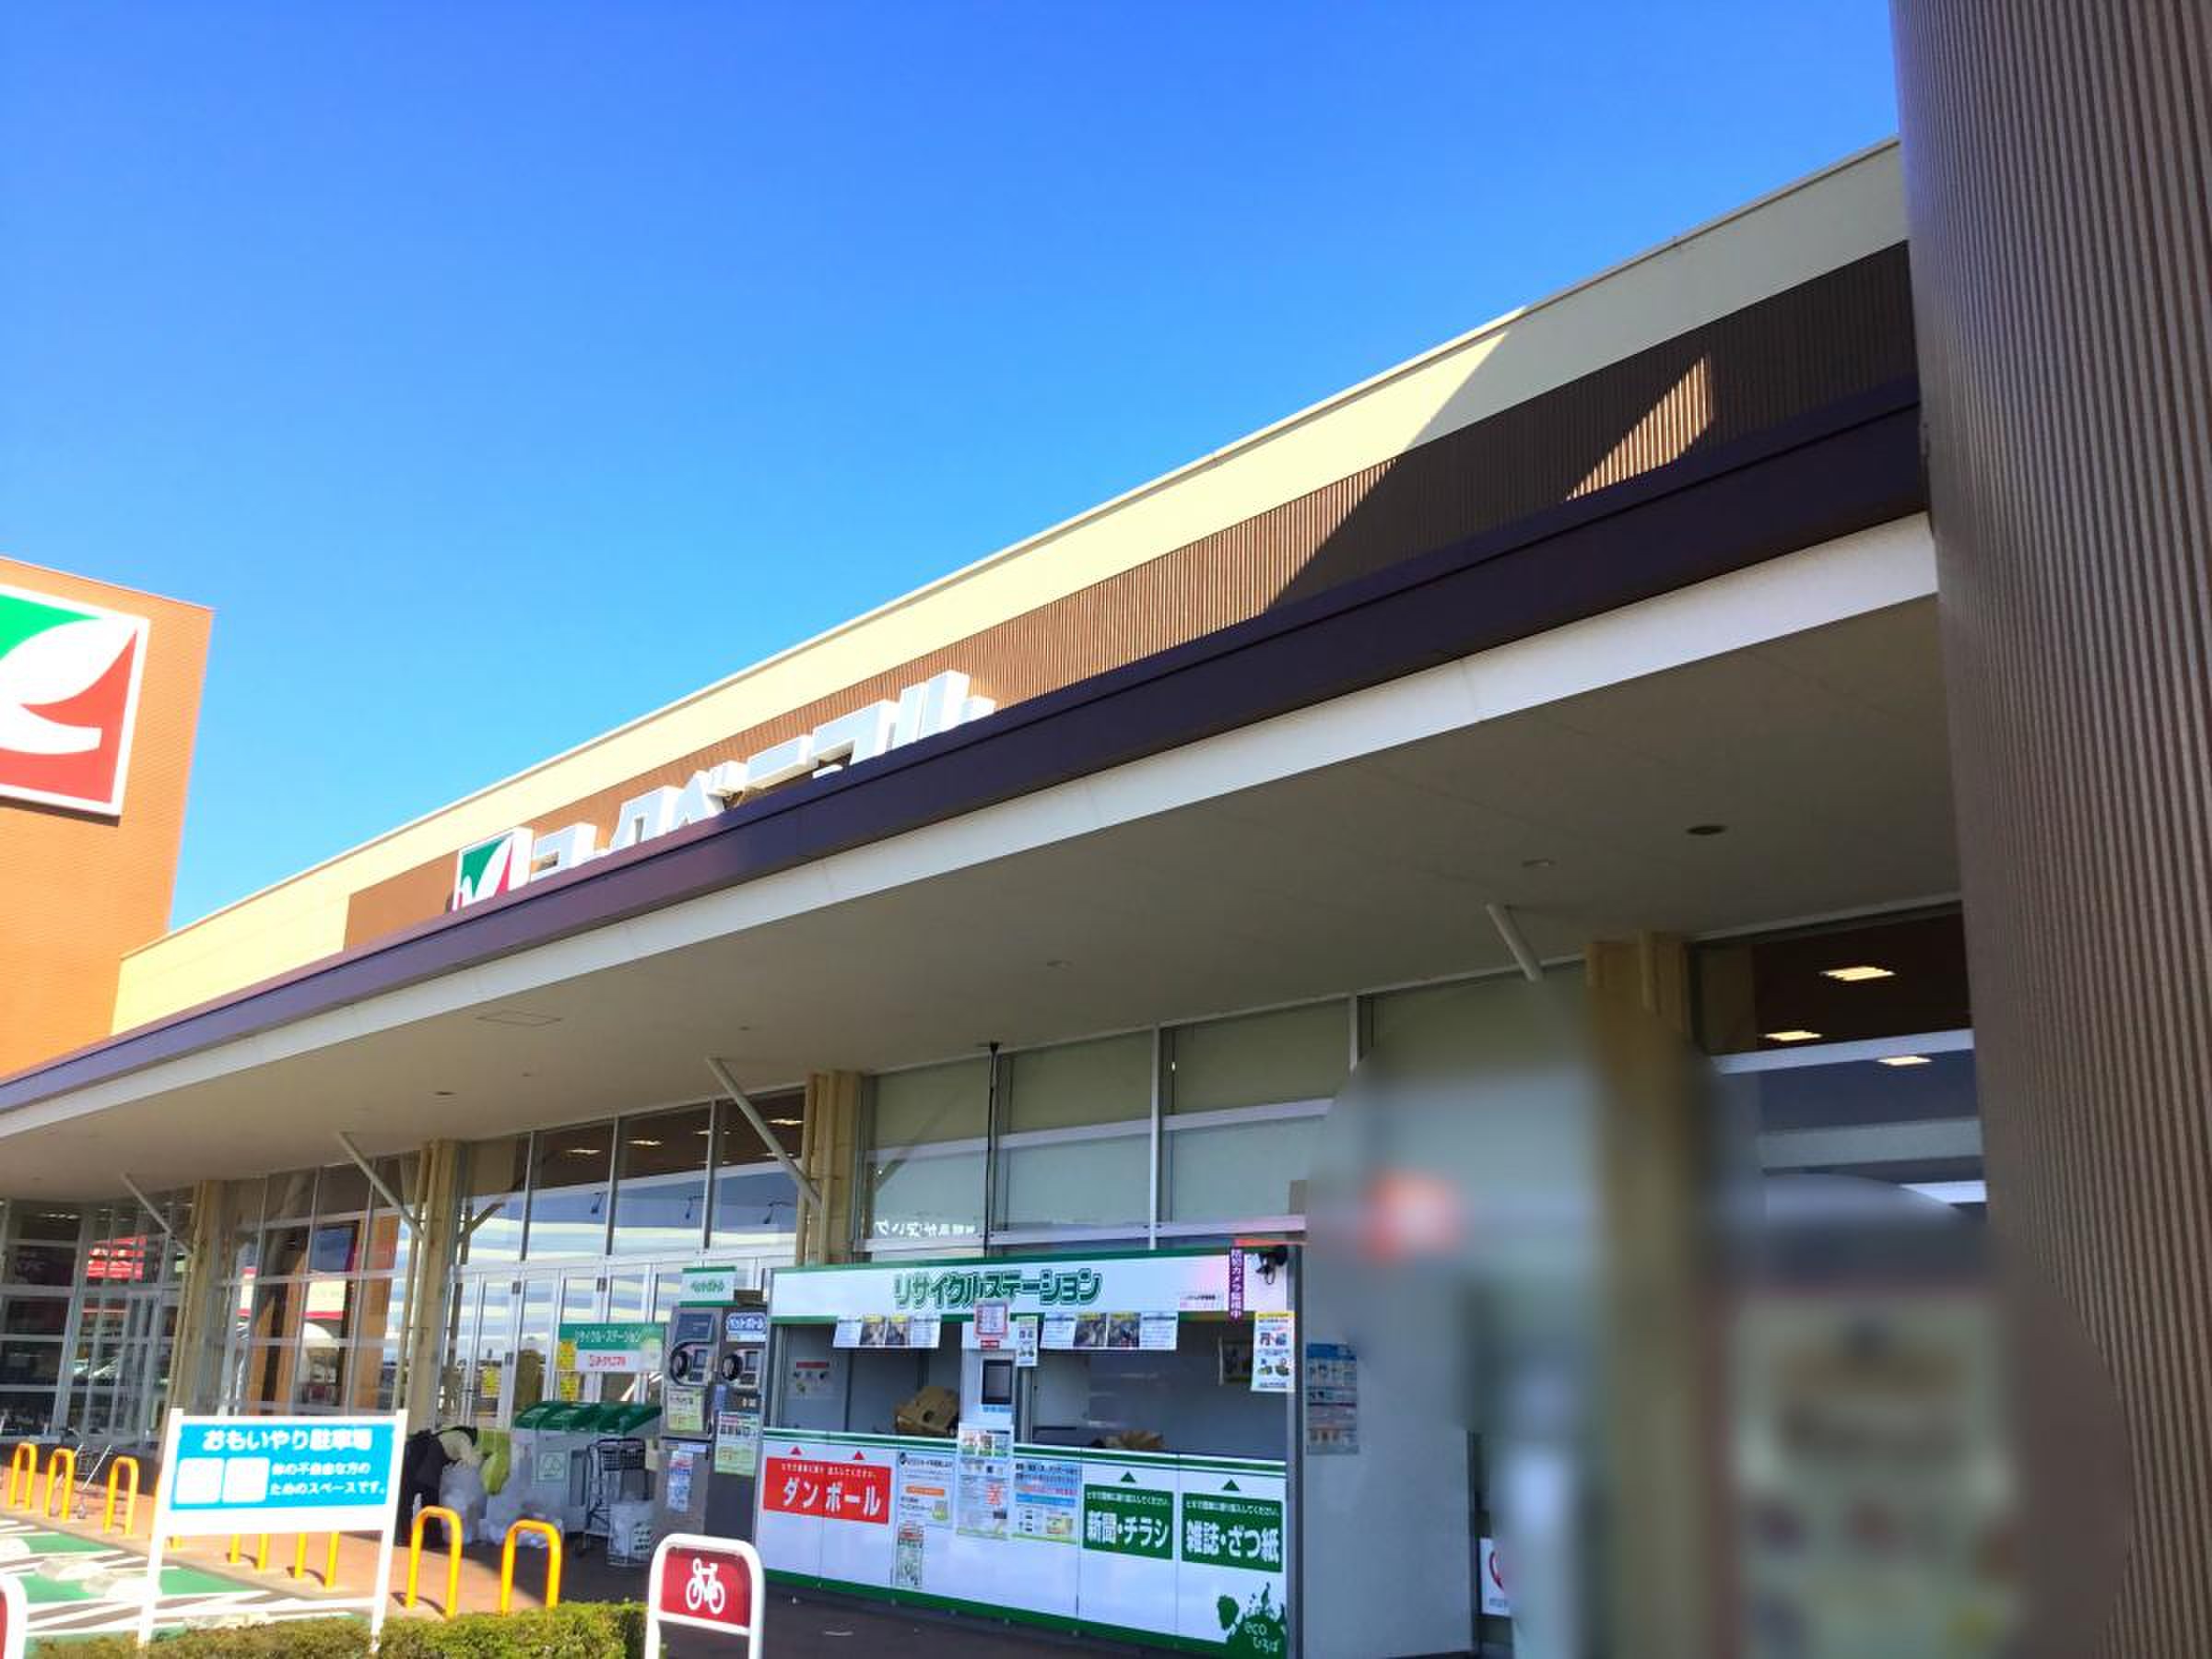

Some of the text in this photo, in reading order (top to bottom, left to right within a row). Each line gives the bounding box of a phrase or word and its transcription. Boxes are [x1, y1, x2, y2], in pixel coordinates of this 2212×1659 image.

[531, 670, 996, 882] ヨクベマル
[893, 1267, 1102, 1310] リサイクルステーション
[783, 1477, 881, 1517] ダンボール
[1087, 1509, 1170, 1548] 新聞・チラシ
[1186, 1518, 1280, 1563] 雑誌・ざつ紙
